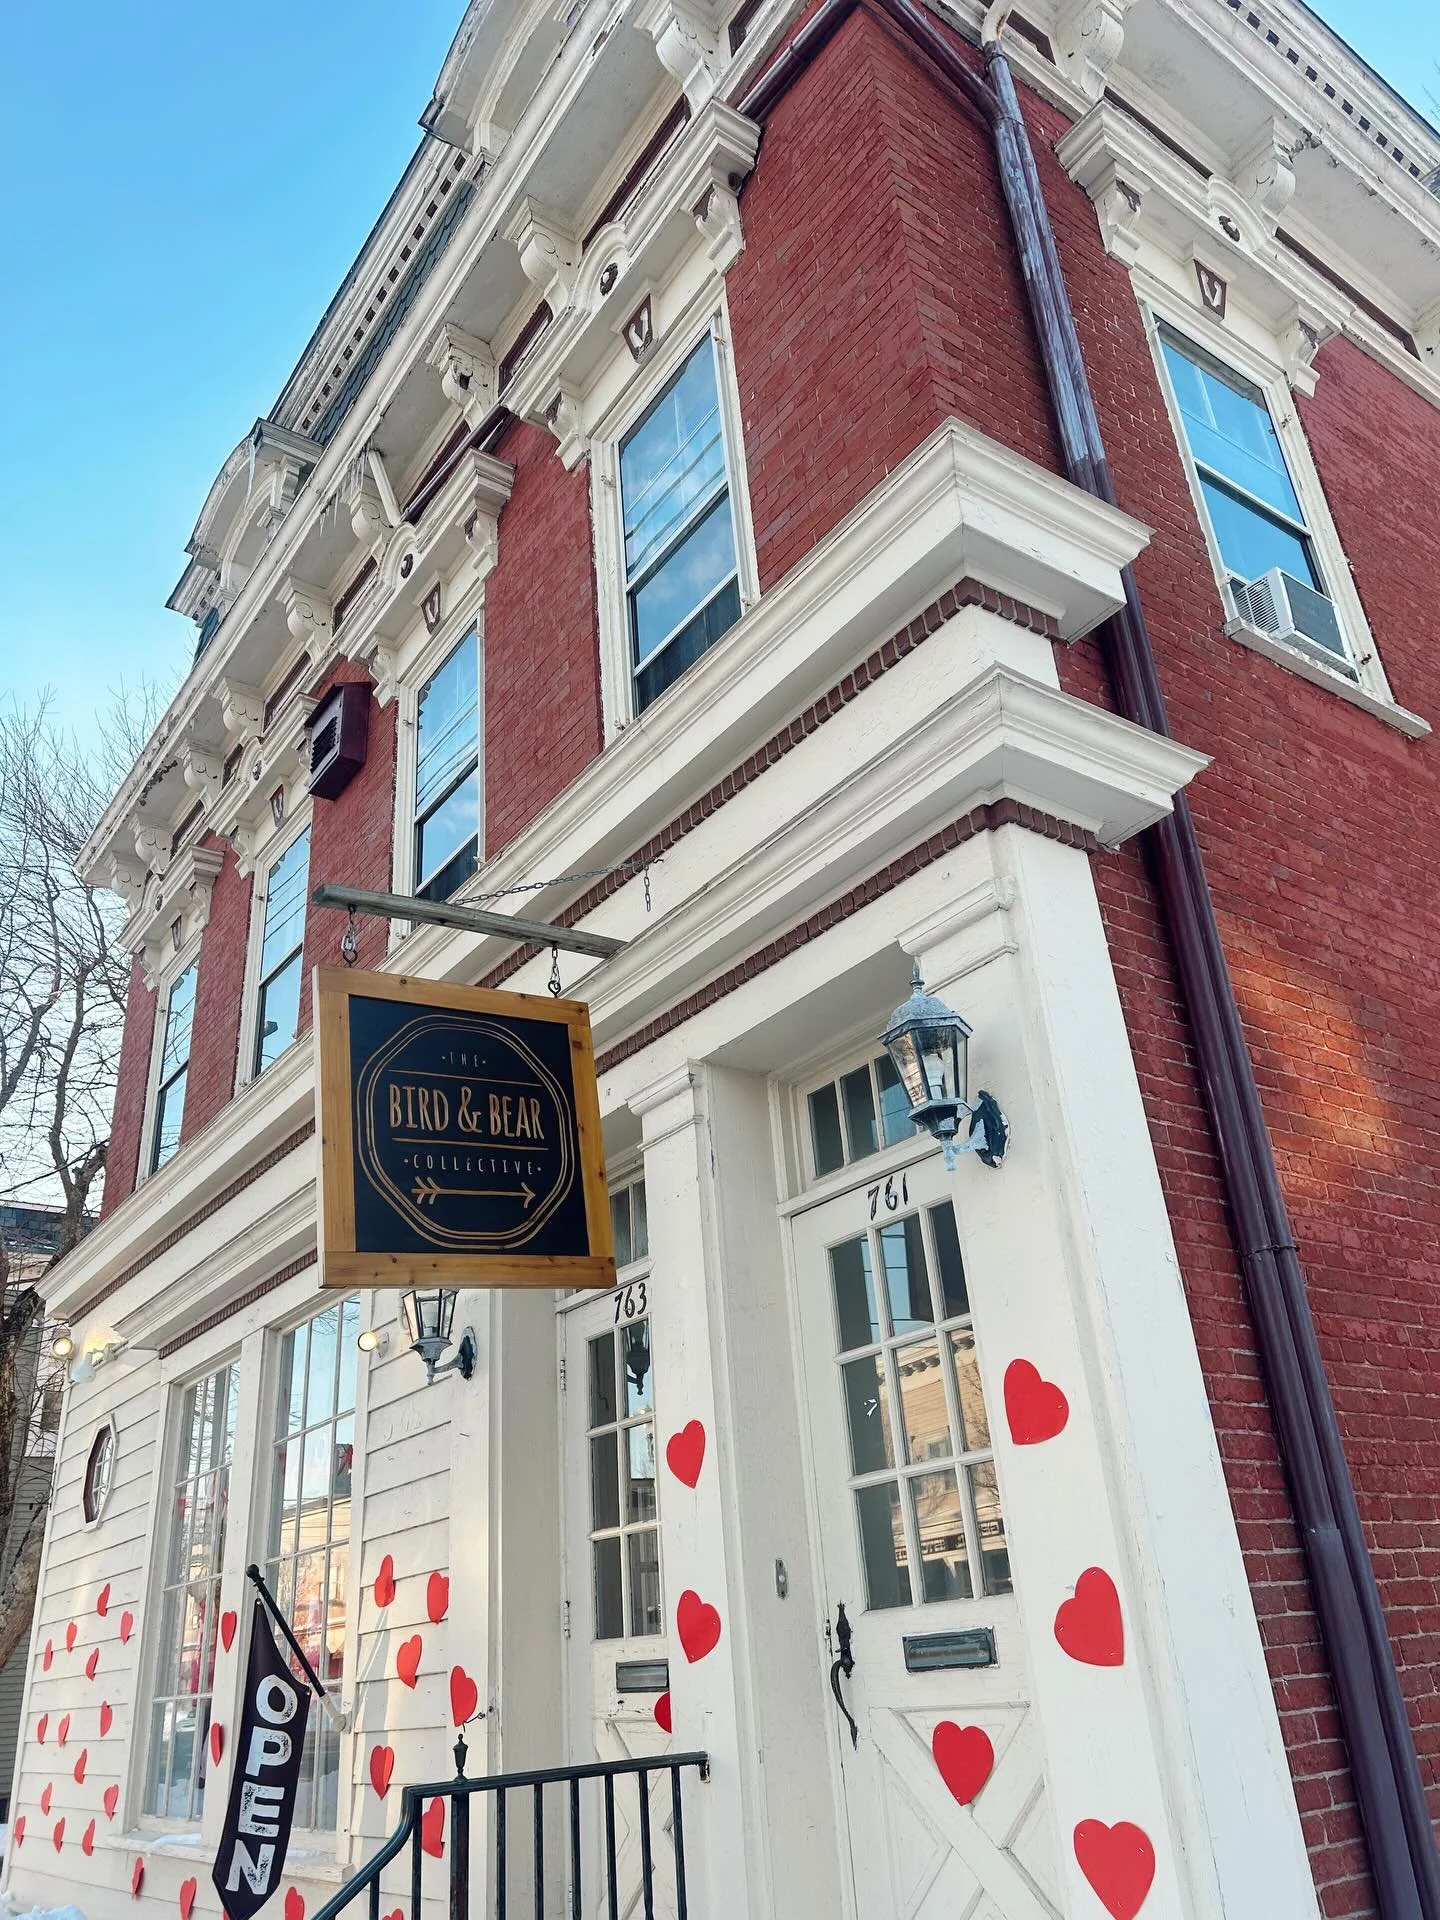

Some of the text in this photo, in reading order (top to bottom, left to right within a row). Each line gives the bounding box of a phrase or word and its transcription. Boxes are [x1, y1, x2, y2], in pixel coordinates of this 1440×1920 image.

[450, 1051, 478, 1068] THE
[389, 1084, 545, 1140] BIRD & BEAR
[413, 1154, 533, 1175] COLLECTIVE
[867, 1172, 909, 1221] 761
[614, 1282, 648, 1324] 763
[225, 1674, 298, 1896] OPEN
